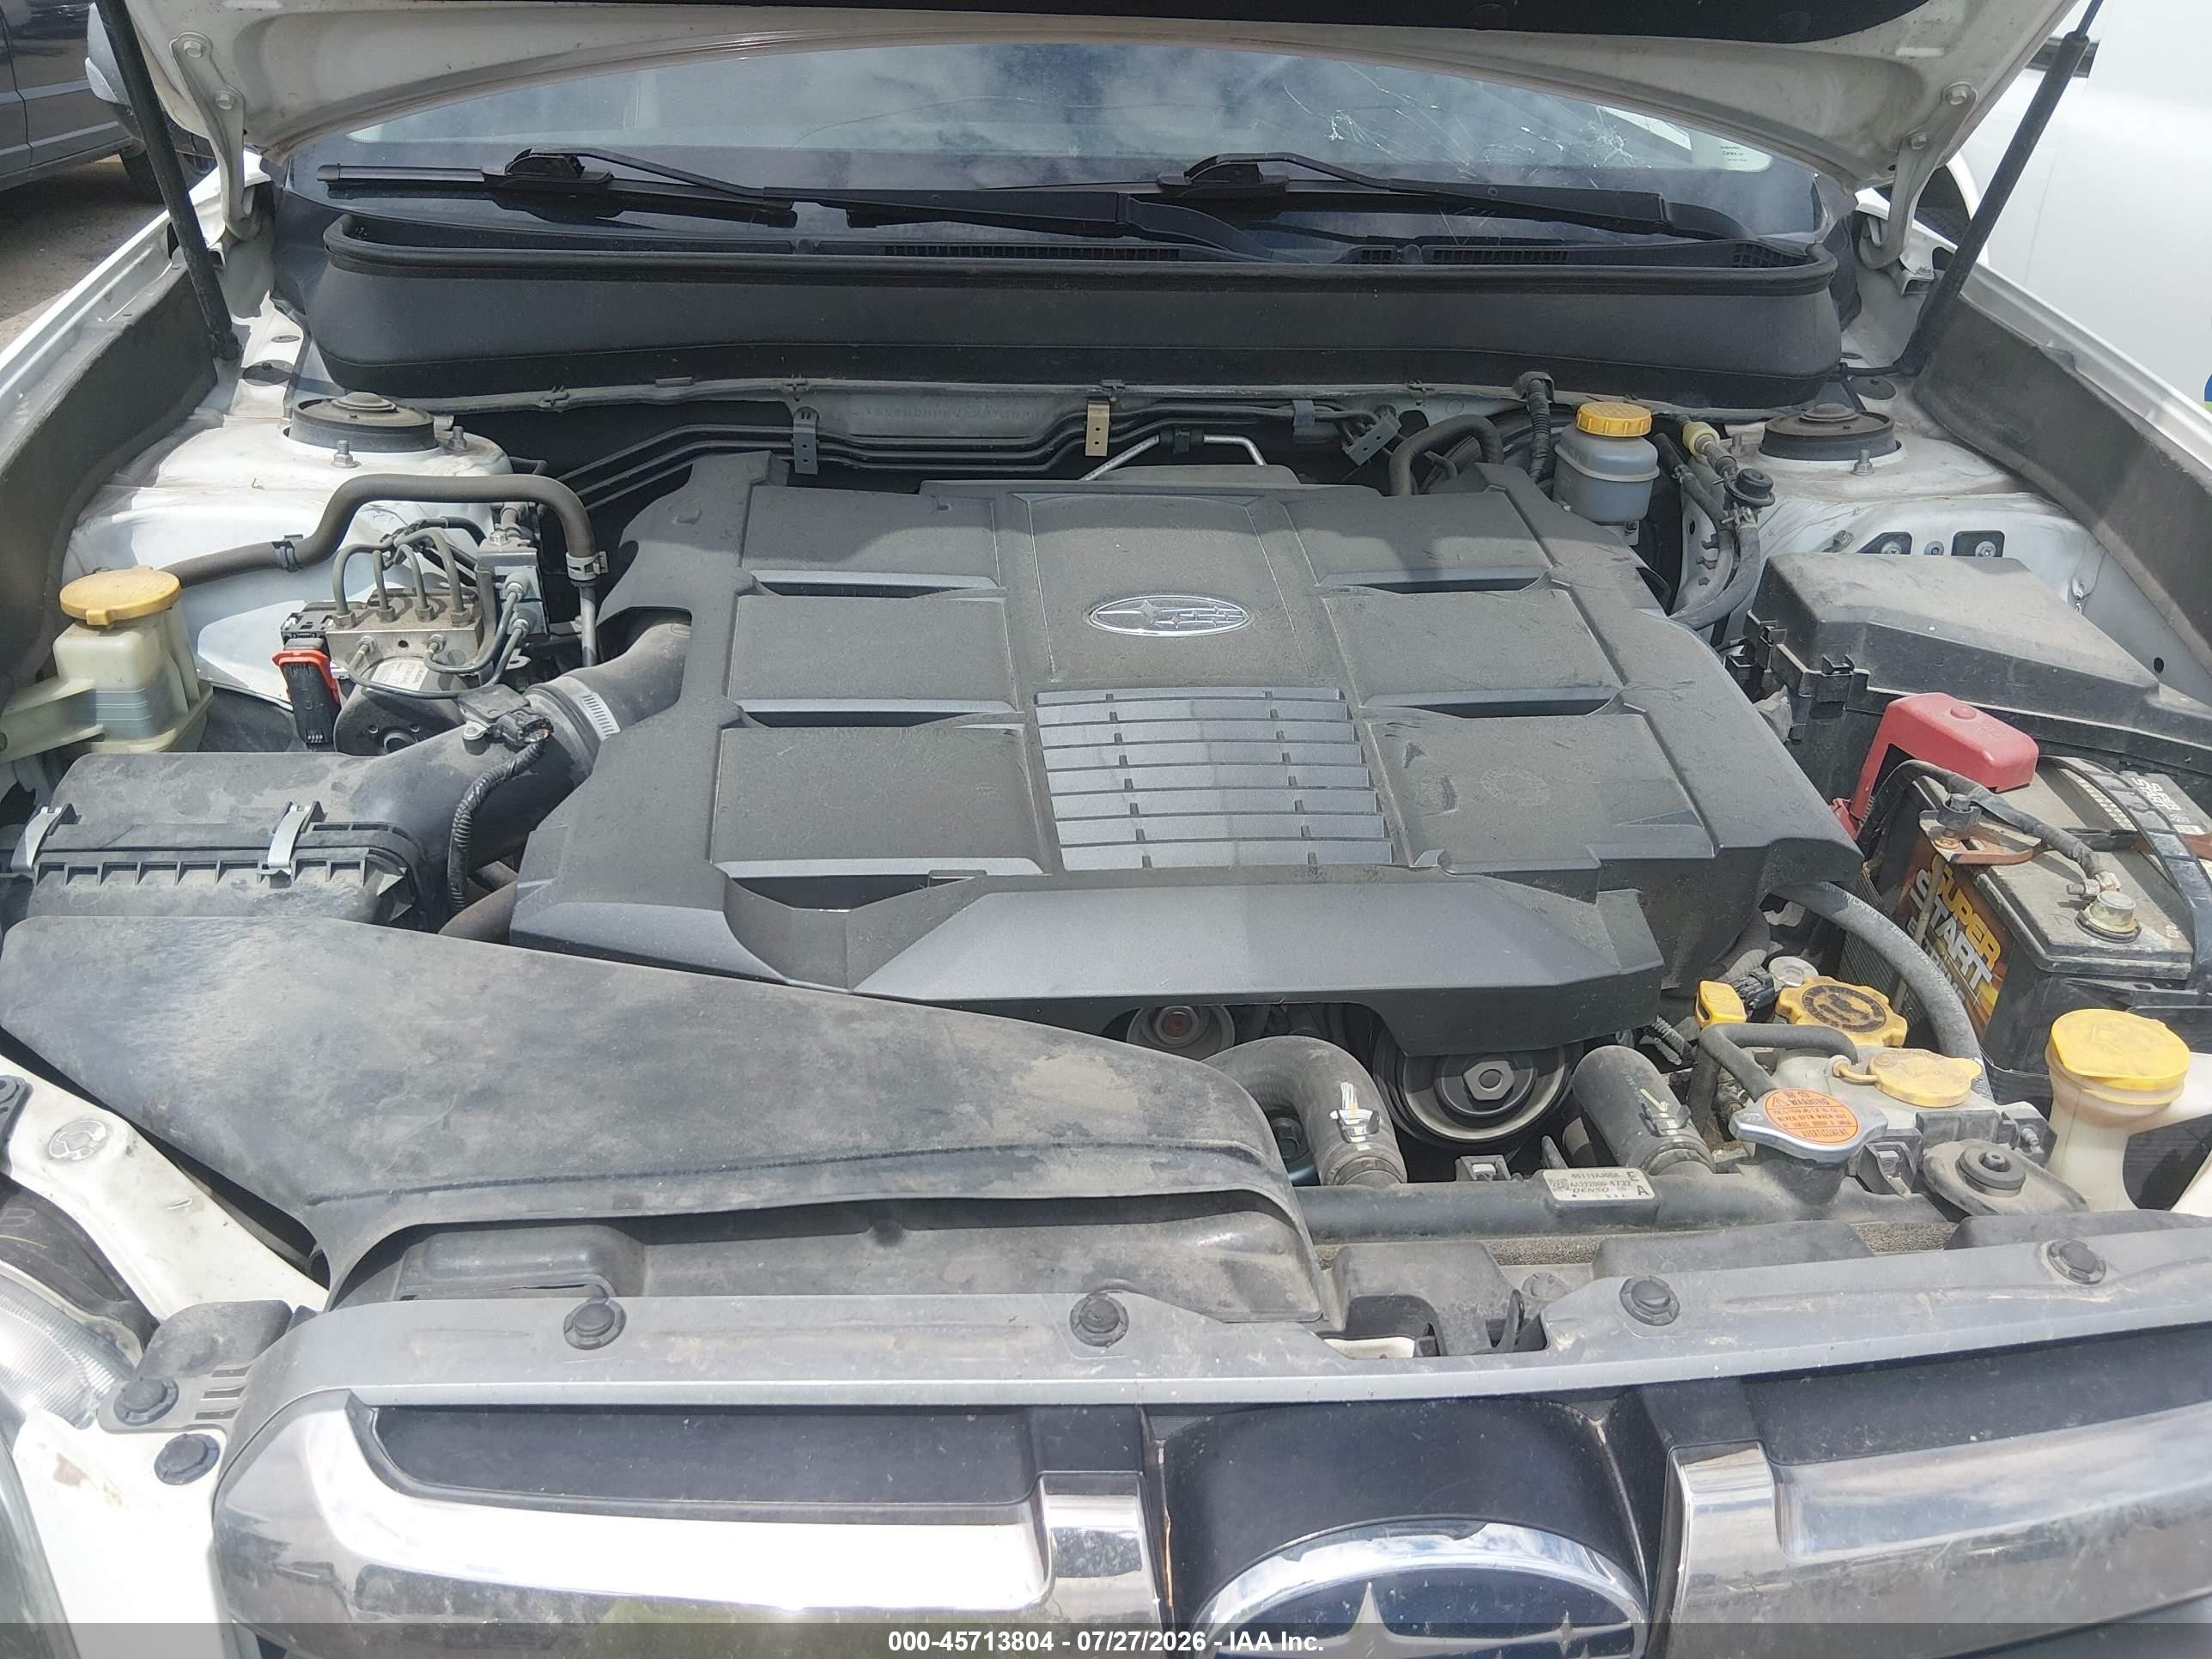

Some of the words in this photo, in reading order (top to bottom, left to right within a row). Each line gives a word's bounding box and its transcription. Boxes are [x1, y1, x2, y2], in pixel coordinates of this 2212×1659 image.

[1909, 869, 1993, 990] START
[1626, 1170, 1639, 1182] E
[1637, 1185, 1649, 1196] A
